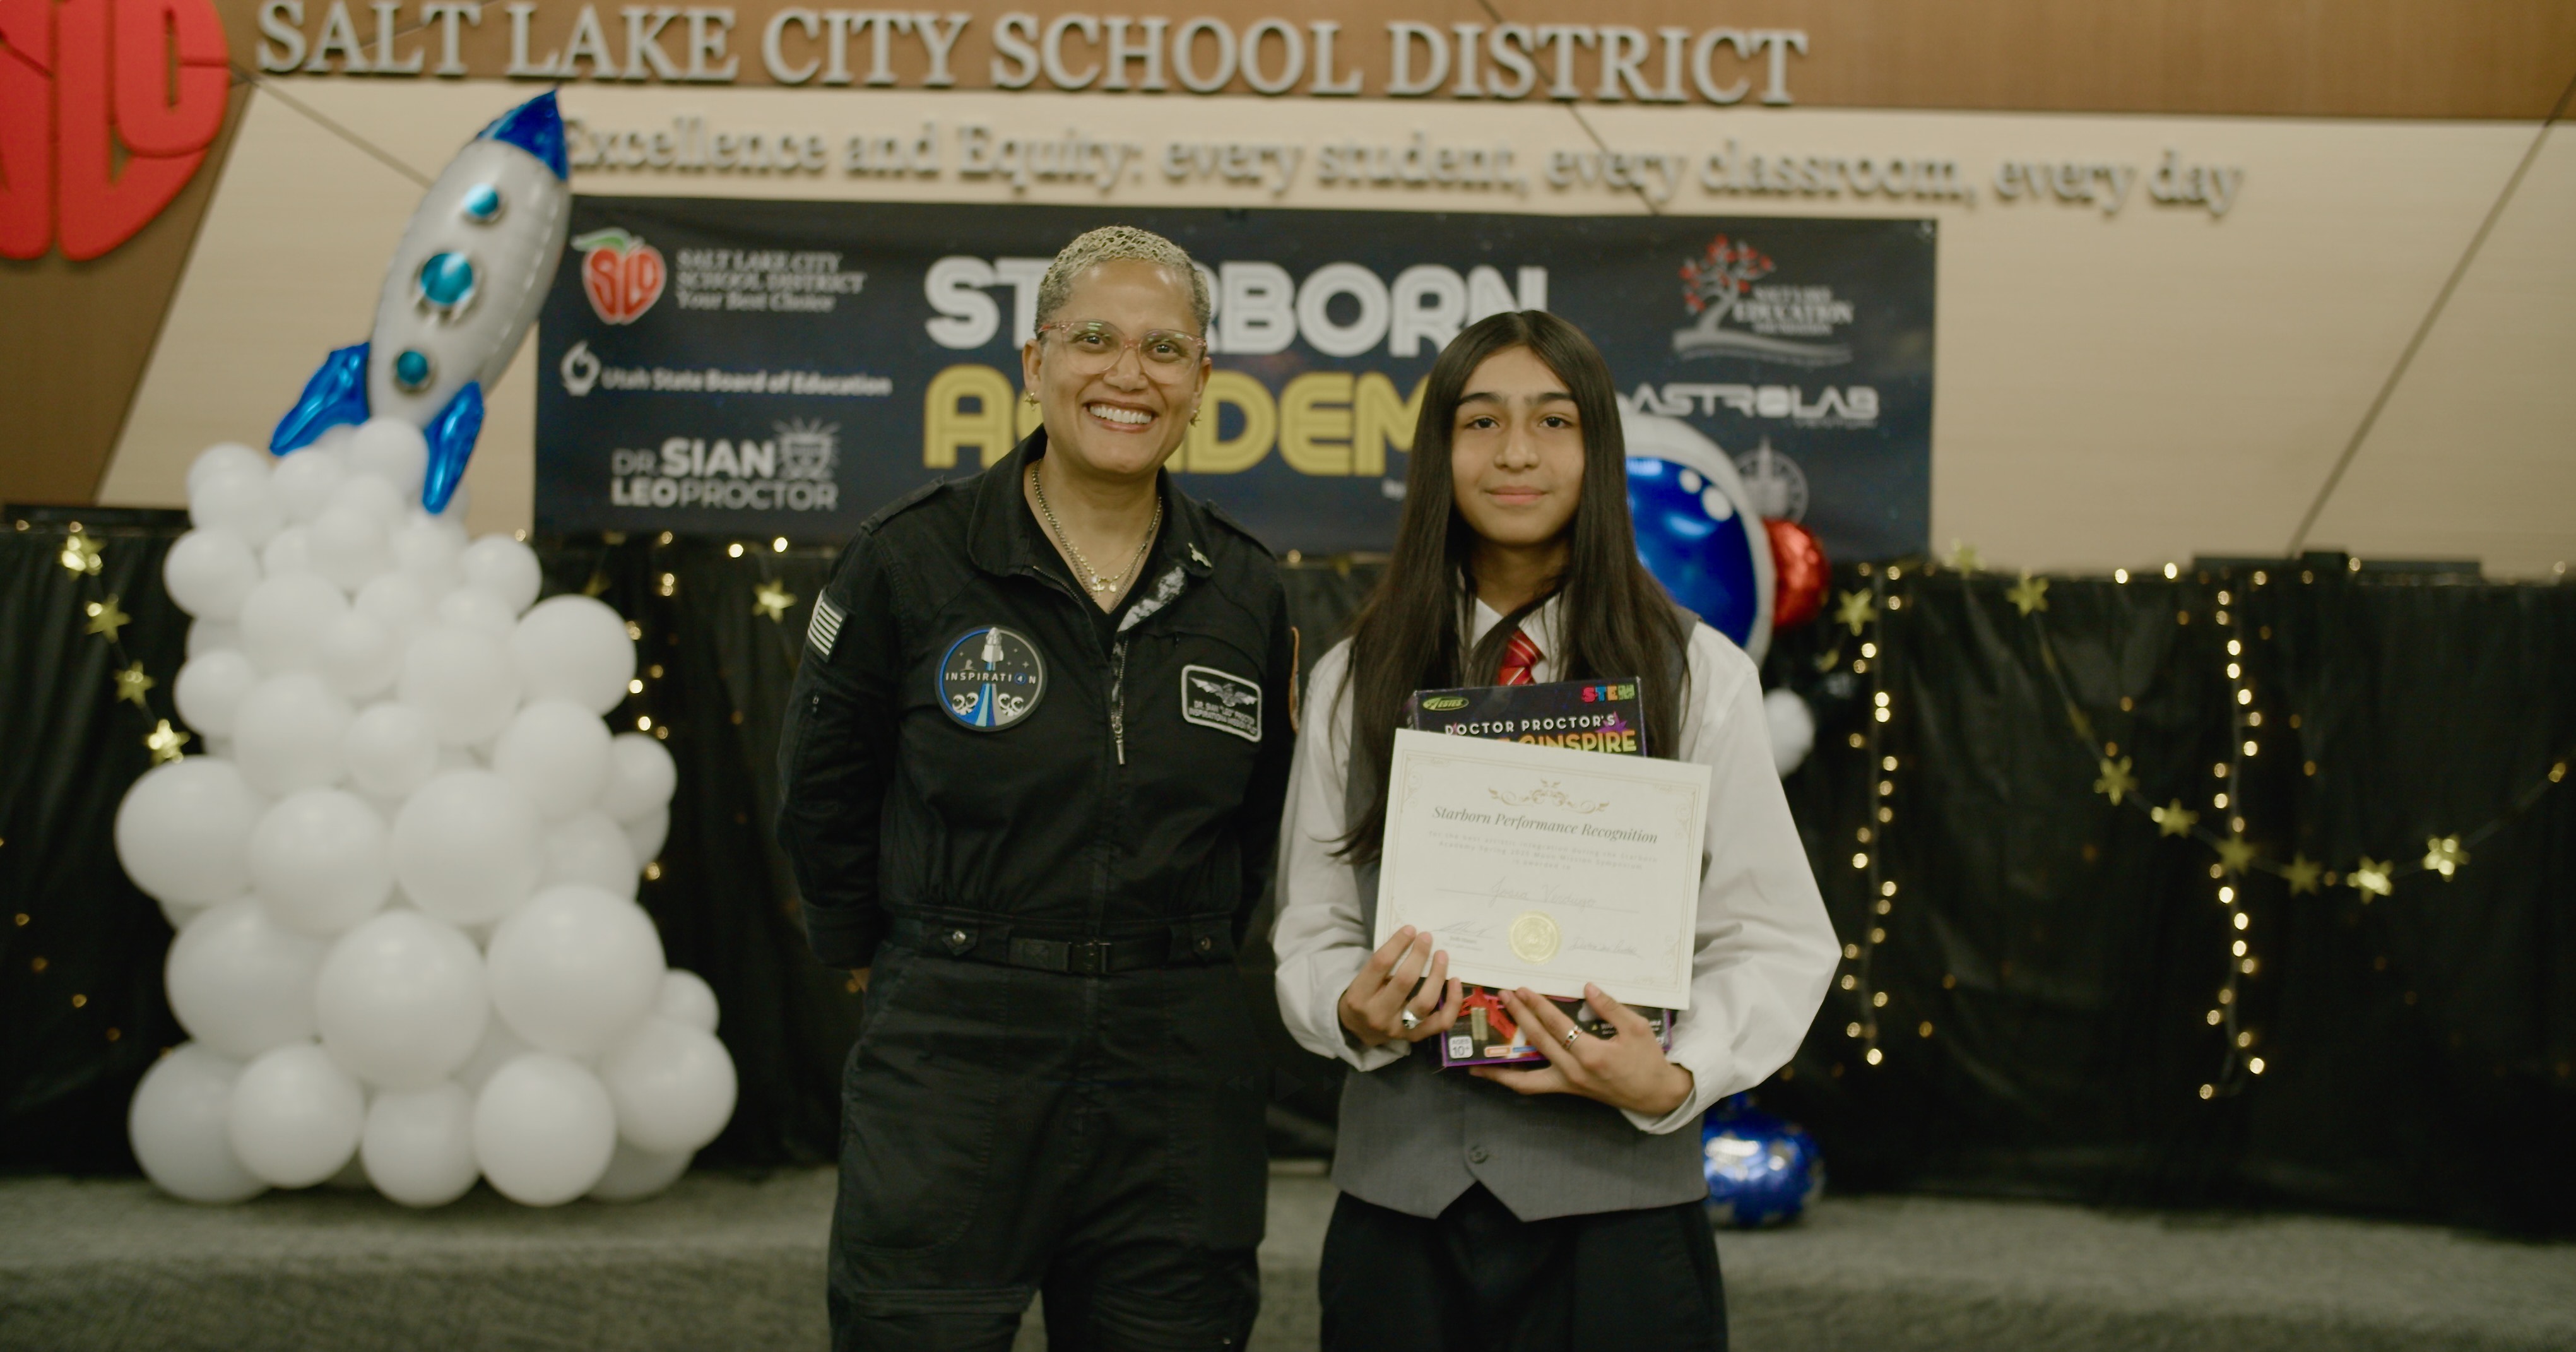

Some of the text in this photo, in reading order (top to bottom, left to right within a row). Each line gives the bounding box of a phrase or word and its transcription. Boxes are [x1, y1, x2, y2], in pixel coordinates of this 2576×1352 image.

[258, 0, 1807, 105] SALT LAKE CITY SCHOOL DISTRICT
[564, 115, 2243, 216] Excellence and Equity: every student, every classroom, every day
[676, 249, 843, 274] SALT LAKE CITY
[676, 271, 868, 294] SCHOOL DISTRICT
[676, 290, 723, 311] Your
[924, 255, 1548, 358] STBORN
[653, 367, 703, 391] State
[705, 369, 767, 393] Board
[767, 370, 792, 394] of
[792, 371, 893, 396] Education
[1631, 382, 1879, 420] ASTROLAB
[923, 364, 1429, 477] ADEM
[660, 439, 776, 478] SIAN
[1582, 684, 1635, 703] STEM
[1445, 714, 1616, 736] DOCTOR PROCTOR'S
[1431, 805, 1658, 845] Starborn Performance Recognition
[1438, 841, 1476, 851] Academy
[1479, 845, 1506, 856] Spring
[1559, 855, 1592, 864] Mission
[1595, 859, 1643, 870] Symposium
[1520, 841, 1568, 852] integration
[1571, 847, 1599, 857] during
[1620, 852, 1658, 863] Starborn
